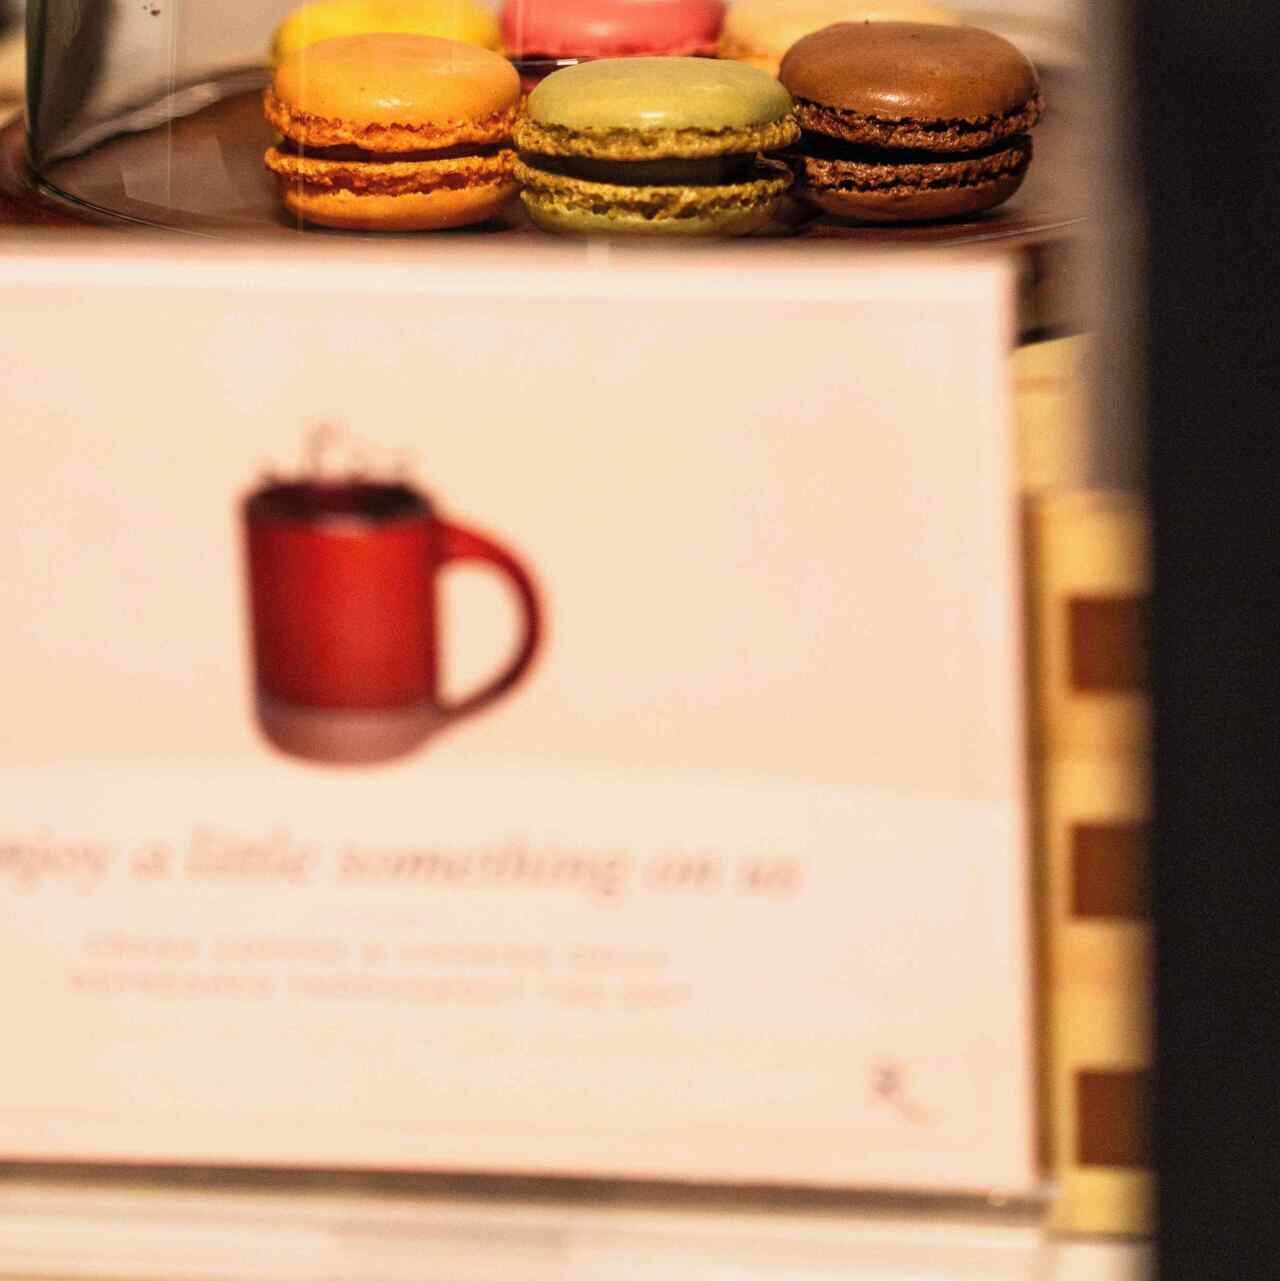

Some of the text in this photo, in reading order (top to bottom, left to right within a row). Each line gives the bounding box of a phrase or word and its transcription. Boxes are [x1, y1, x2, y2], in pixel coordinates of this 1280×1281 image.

[129, 840, 170, 883] a
[185, 820, 317, 885] little
[337, 832, 634, 906] something
[644, 851, 721, 892] on
